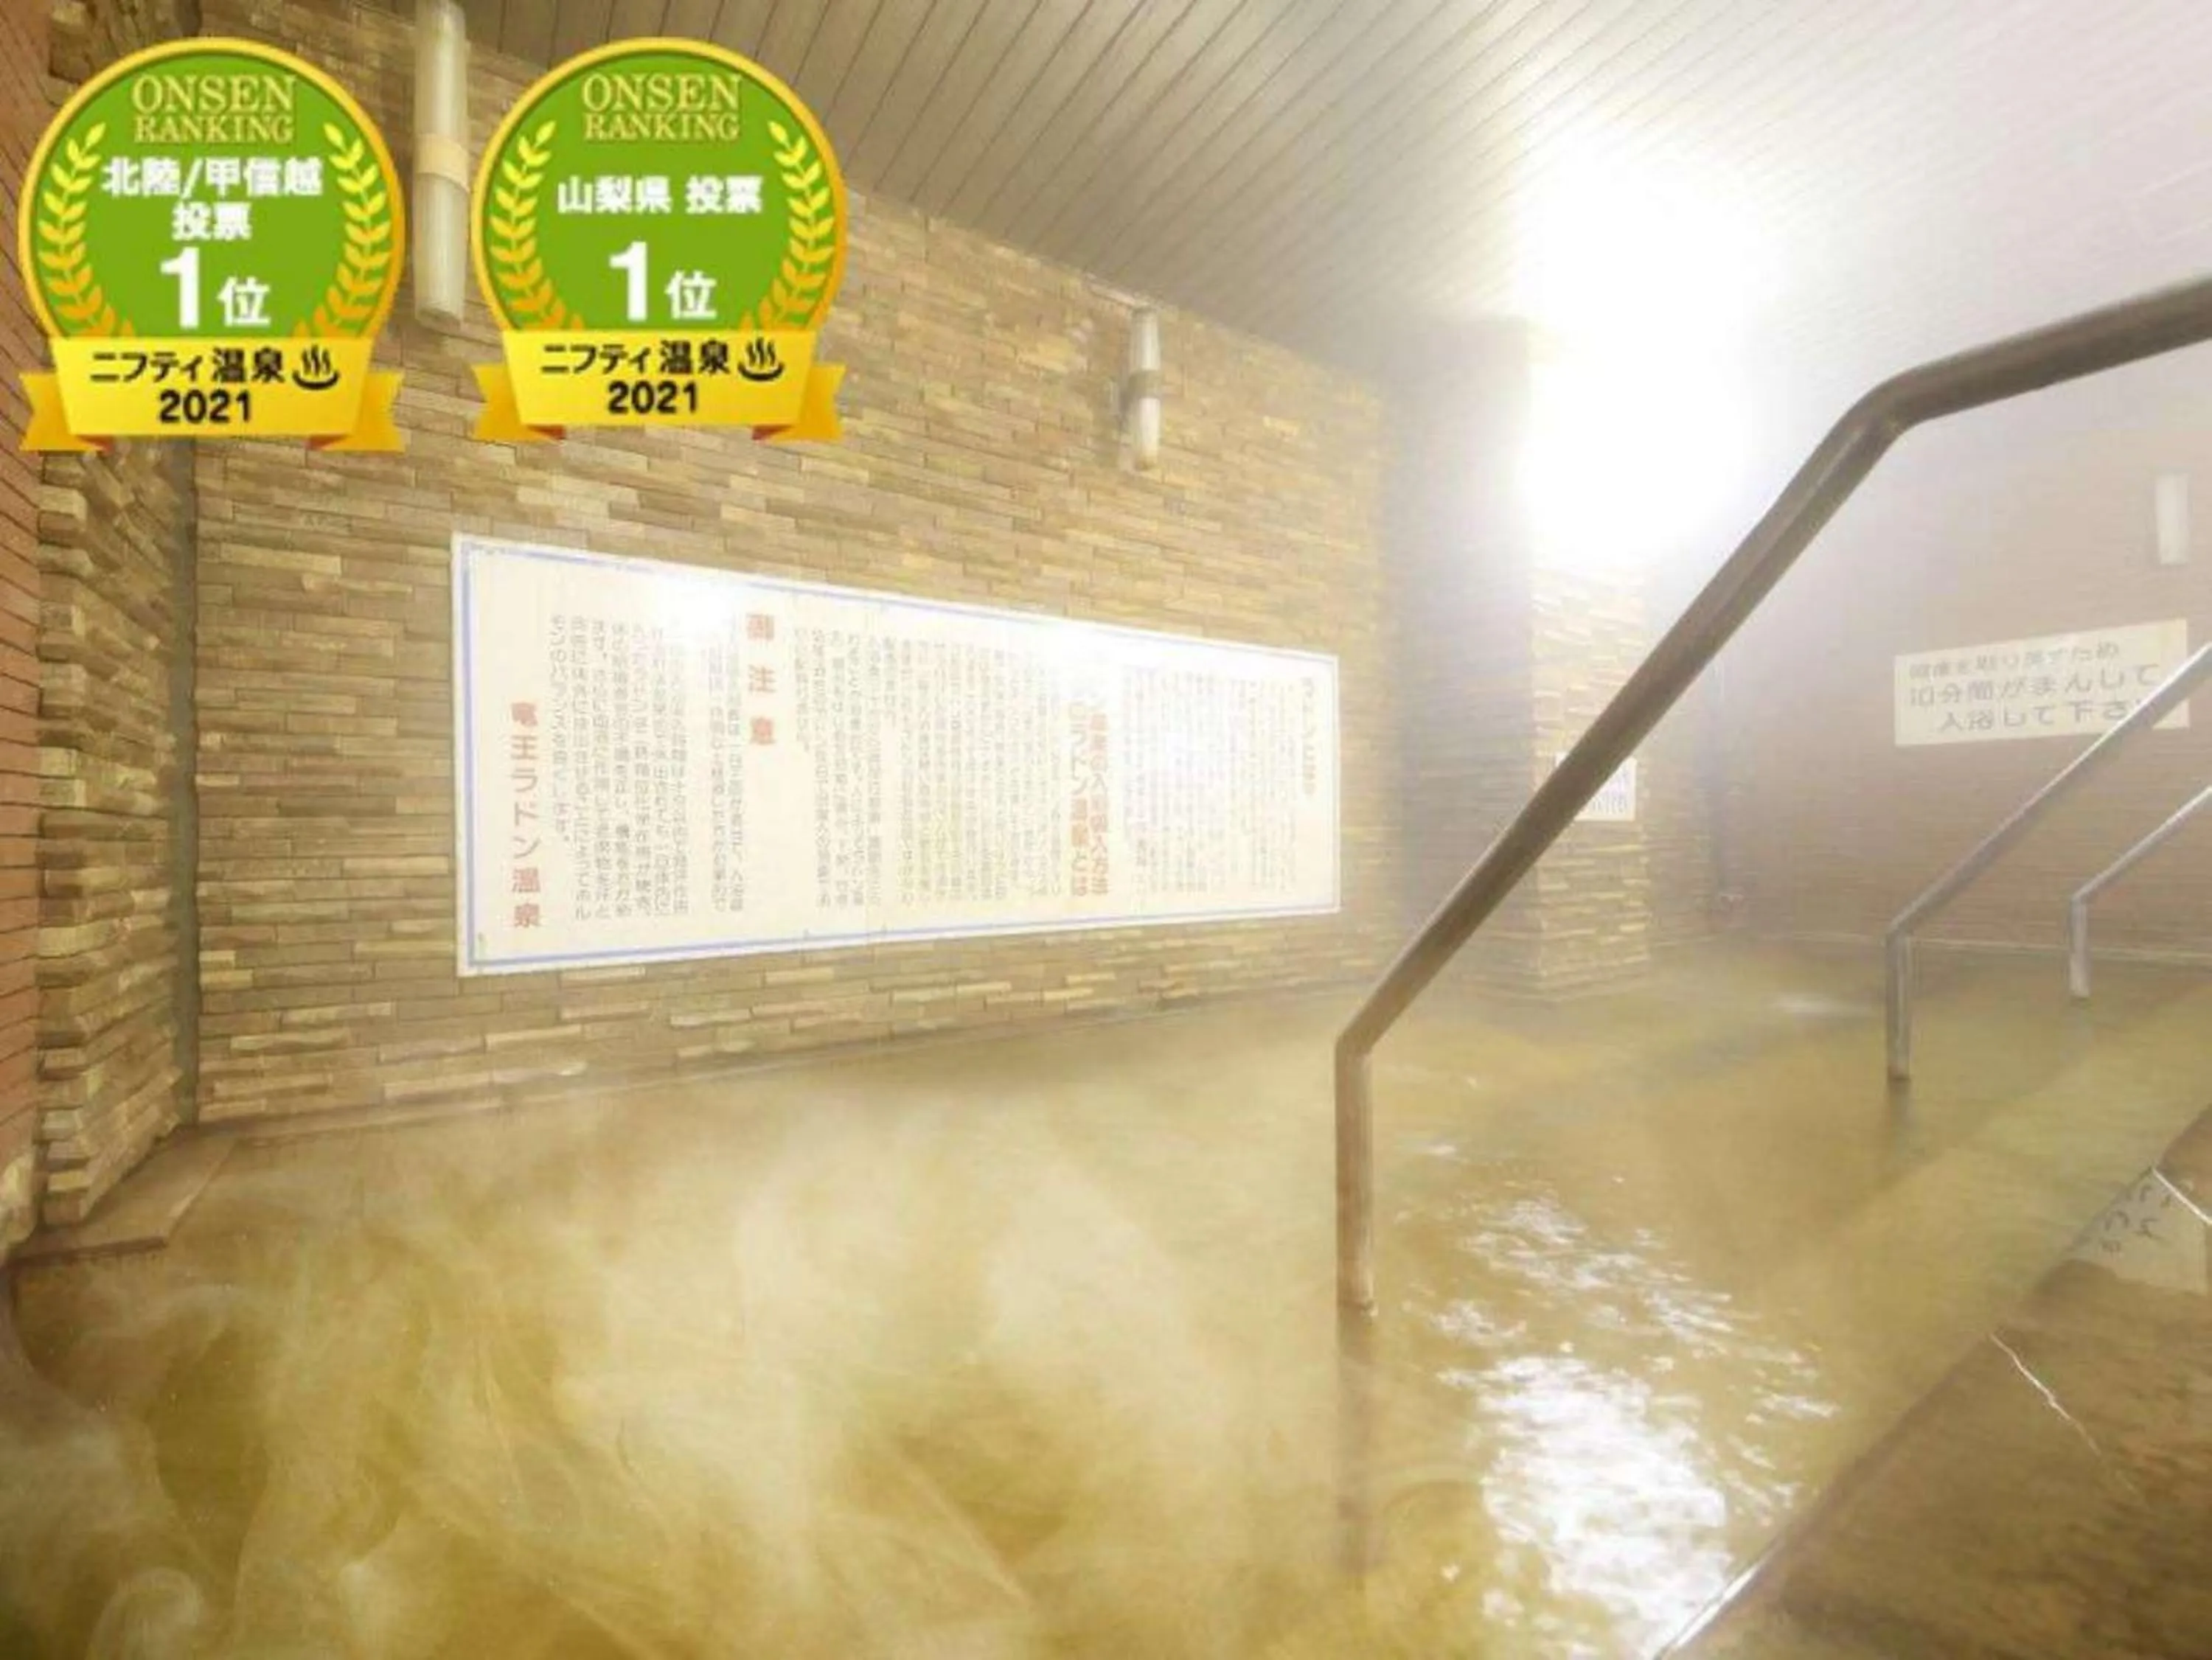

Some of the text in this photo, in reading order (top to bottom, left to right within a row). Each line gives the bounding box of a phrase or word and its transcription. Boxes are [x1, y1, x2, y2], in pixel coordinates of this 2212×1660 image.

[1938, 699, 2134, 733] 入浴して下さ
